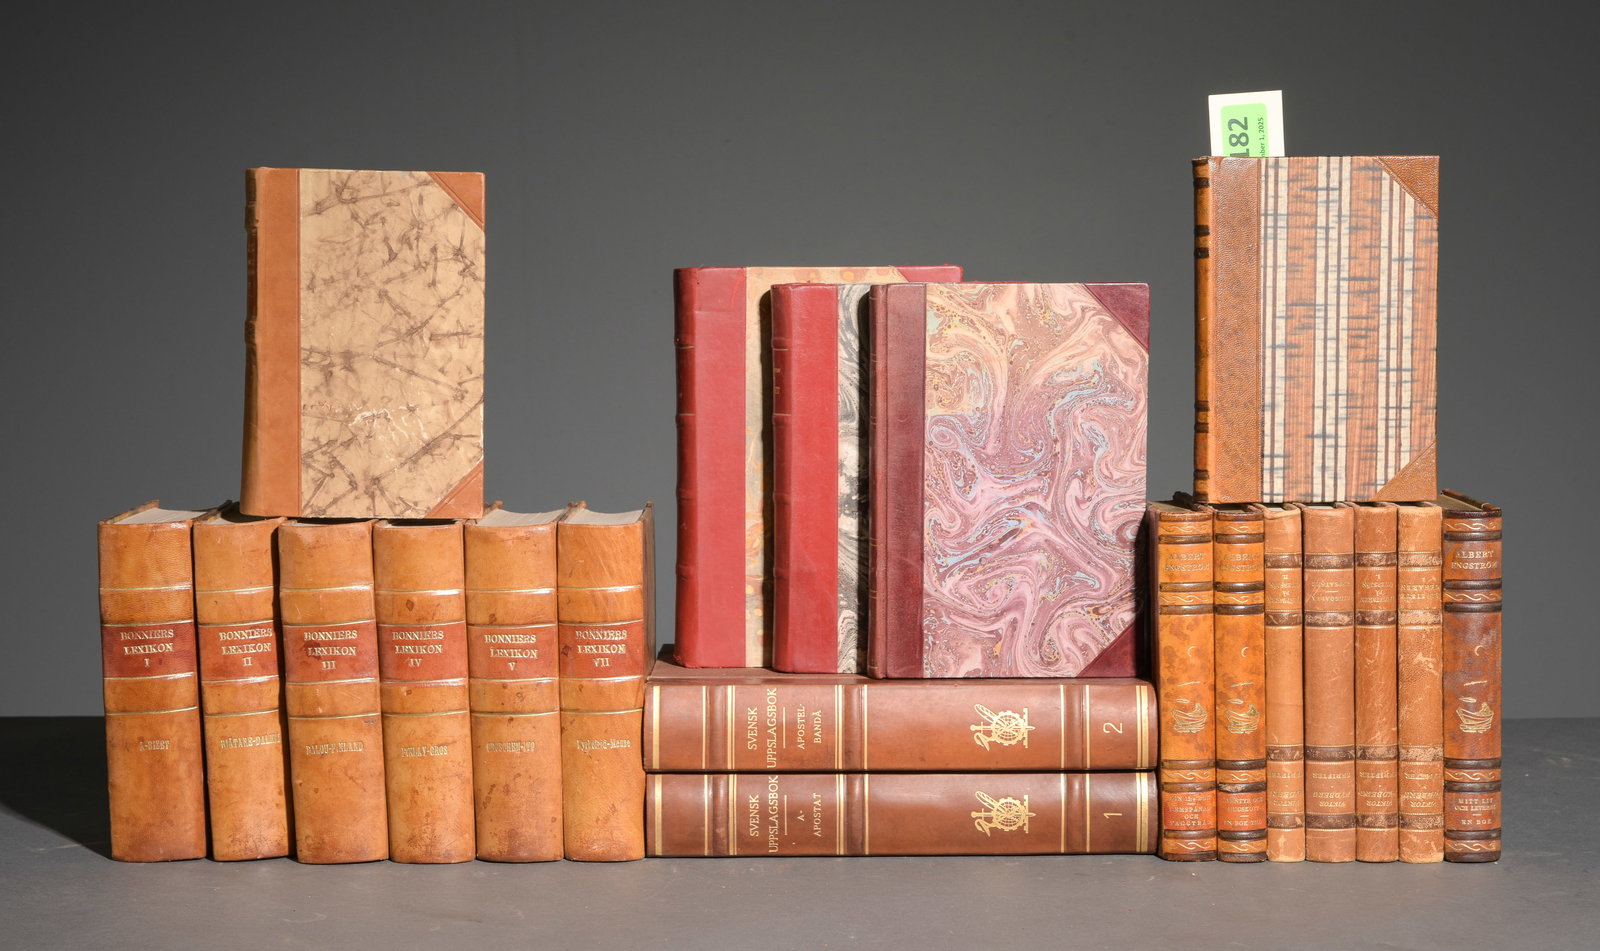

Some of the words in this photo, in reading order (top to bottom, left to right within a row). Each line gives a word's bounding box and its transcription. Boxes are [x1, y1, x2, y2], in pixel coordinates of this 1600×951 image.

[1455, 550, 1494, 559] ALBERT
[120, 628, 174, 640] BONNIERS
[219, 628, 273, 641] BONNIERS
[304, 630, 358, 641] BONNIERS
[392, 630, 445, 641] BONNIERS
[484, 634, 538, 644] BONNIERS
[575, 629, 628, 641] BONNIERS
[124, 642, 174, 656] LEXIKON
[221, 642, 272, 655] LEXIKON
[307, 646, 356, 657] LEXIKON
[394, 645, 443, 655] LEXIKON
[490, 648, 538, 659] LEXIKON
[577, 644, 626, 655] LEXIKON
[243, 657, 252, 666] II
[321, 660, 336, 670] III
[408, 658, 422, 667] IV
[508, 662, 516, 672] V
[592, 658, 610, 667] VII
[747, 706, 758, 750] SVENSK
[766, 687, 777, 769] UPPSLAGSBOK
[1103, 722, 1123, 734] 2
[749, 794, 760, 837] SVENSK
[768, 775, 779, 853] UPPSLAGSBOK
[813, 792, 822, 837] APOSTAT
